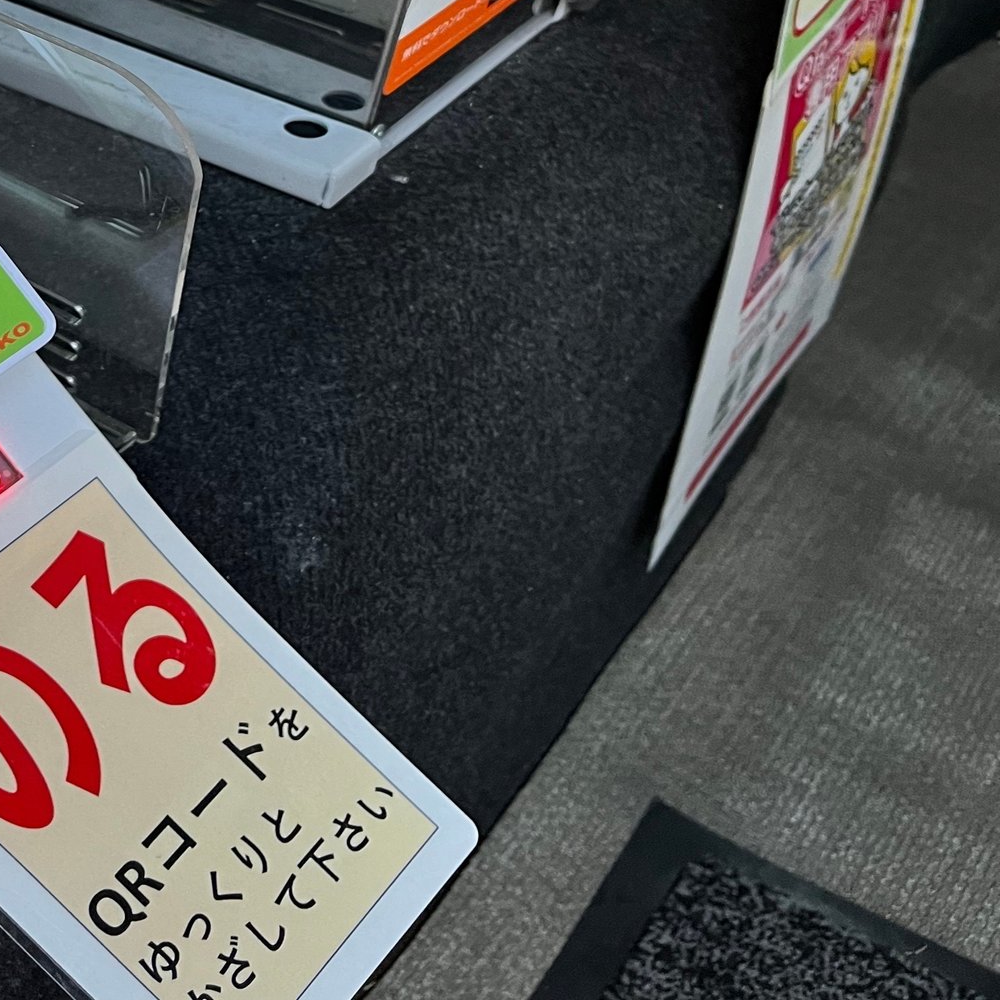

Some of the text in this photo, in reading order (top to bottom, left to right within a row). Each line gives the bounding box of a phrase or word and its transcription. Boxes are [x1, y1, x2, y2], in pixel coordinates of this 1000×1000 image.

[88, 706, 309, 936] QRコードを
[138, 808, 301, 984] ゆっくりと
